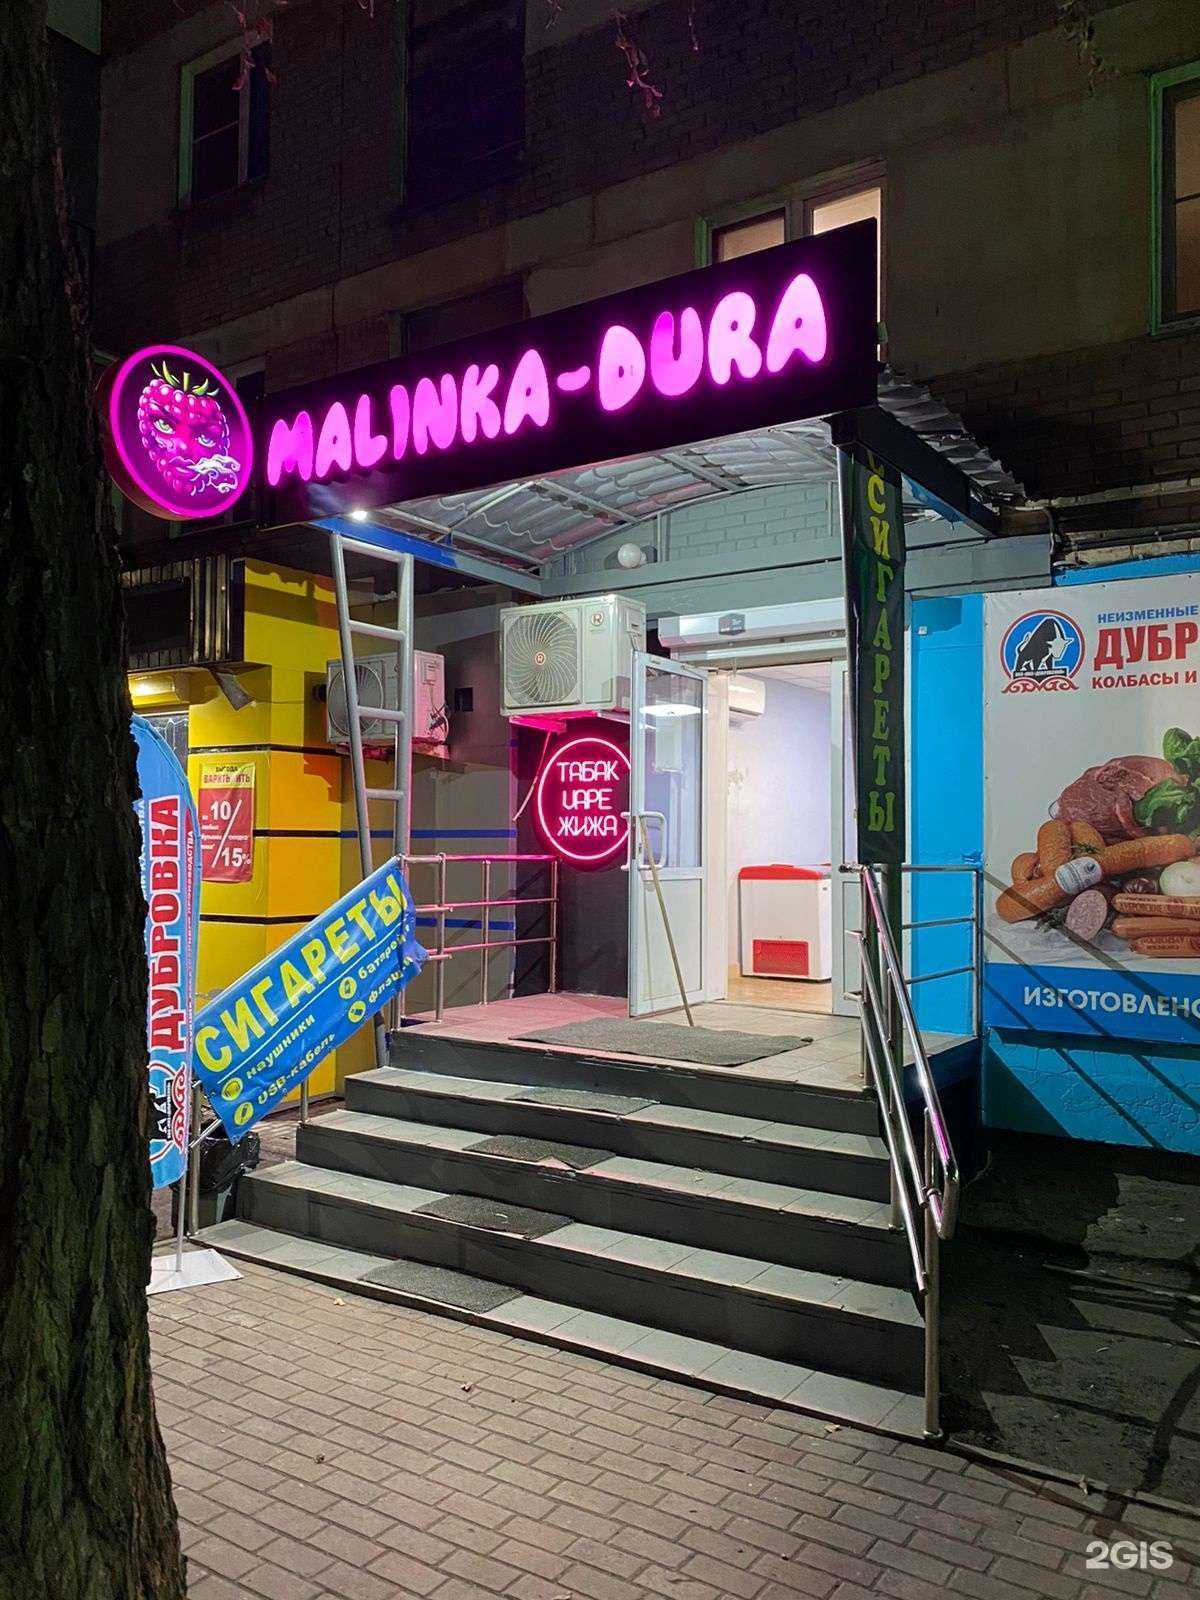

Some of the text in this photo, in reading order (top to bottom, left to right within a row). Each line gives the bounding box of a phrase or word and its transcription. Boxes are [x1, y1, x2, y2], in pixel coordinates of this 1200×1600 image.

[267, 273, 828, 487] MALINKA-DURA
[1097, 605, 1199, 624] НЕИЗМЕННЫЕ
[867, 474, 896, 832] СИГАРЕТЫ
[1094, 622, 1199, 671] ДУБР
[1092, 670, 1197, 689] КОЛБАСЫ И
[557, 761, 620, 782] ТАБАК
[210, 801, 232, 820] 10
[557, 815, 618, 837] ЖИЖА
[150, 797, 186, 1051] ДУБРОВКА
[195, 873, 408, 1073] СИГАРЕТЫ
[246, 1013, 315, 1080] наушники
